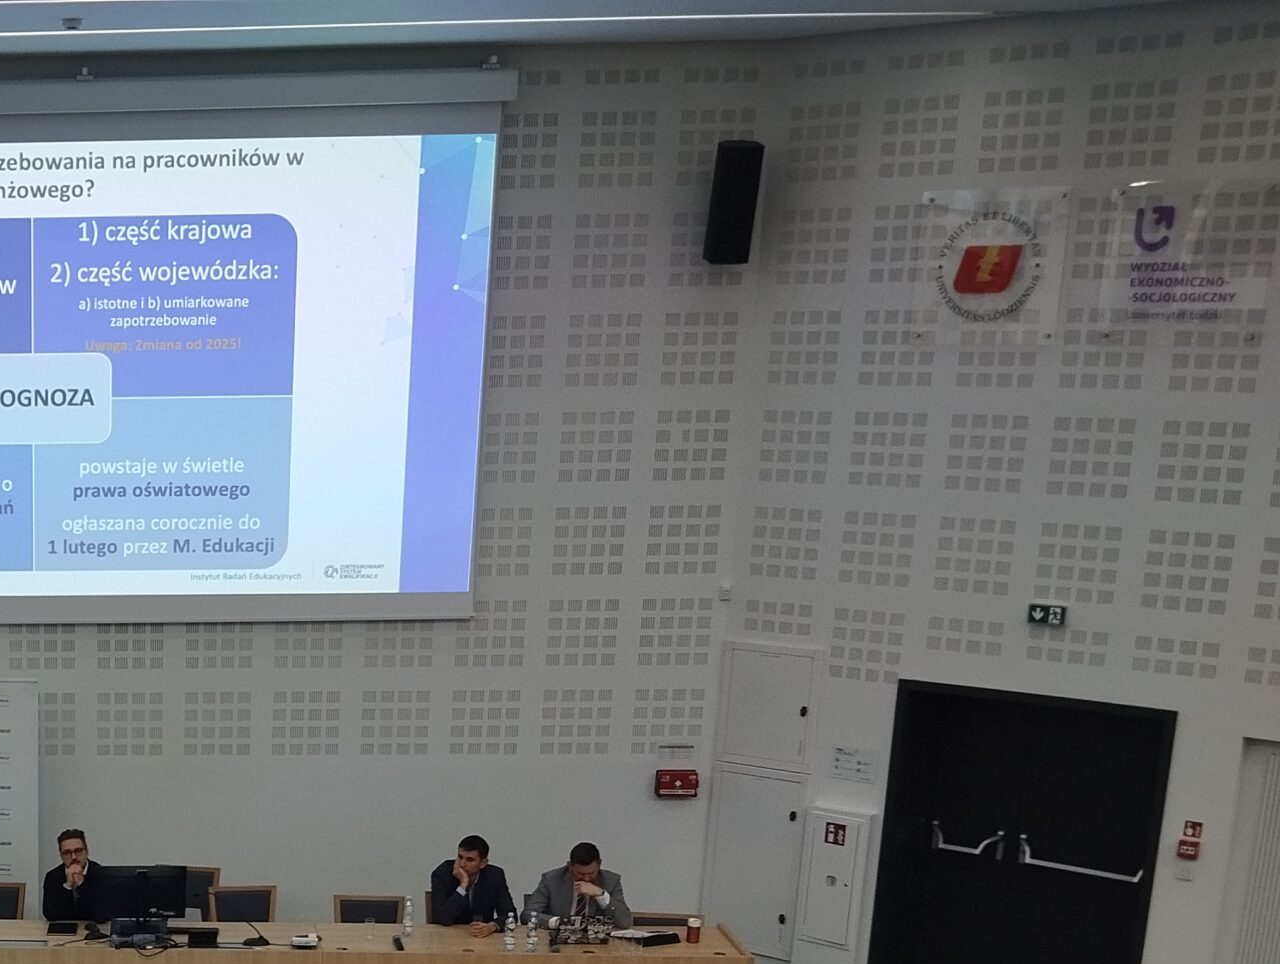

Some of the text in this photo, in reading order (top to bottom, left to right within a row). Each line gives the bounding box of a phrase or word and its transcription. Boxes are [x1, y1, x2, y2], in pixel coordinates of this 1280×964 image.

[112, 153, 136, 170] na
[142, 148, 280, 173] pracowników
[286, 150, 304, 166] w
[77, 218, 253, 246] 1) część krajowa
[49, 260, 279, 287] 2) część wojewódzka:
[1130, 262, 1188, 273] WYDZIAŁ
[1130, 276, 1230, 288] EKONOMICZNO-
[78, 295, 250, 313] a) istotne i b) umiarkowane
[1129, 291, 1237, 303] -SOCJOLOGICZNY
[110, 313, 217, 330] zapotrzebowanie
[135, 338, 182, 351] Zmiana
[186, 337, 202, 350] od
[79, 456, 245, 479] powstaje w świetle
[1, 479, 13, 492] o
[73, 481, 250, 501] prawa oświatowego
[62, 512, 261, 535] ogłaszana corocznie do
[48, 536, 275, 559] 1 lutego przez M. Edukacji
[190, 571, 302, 583] Instytut Badań Edukacyjnych
